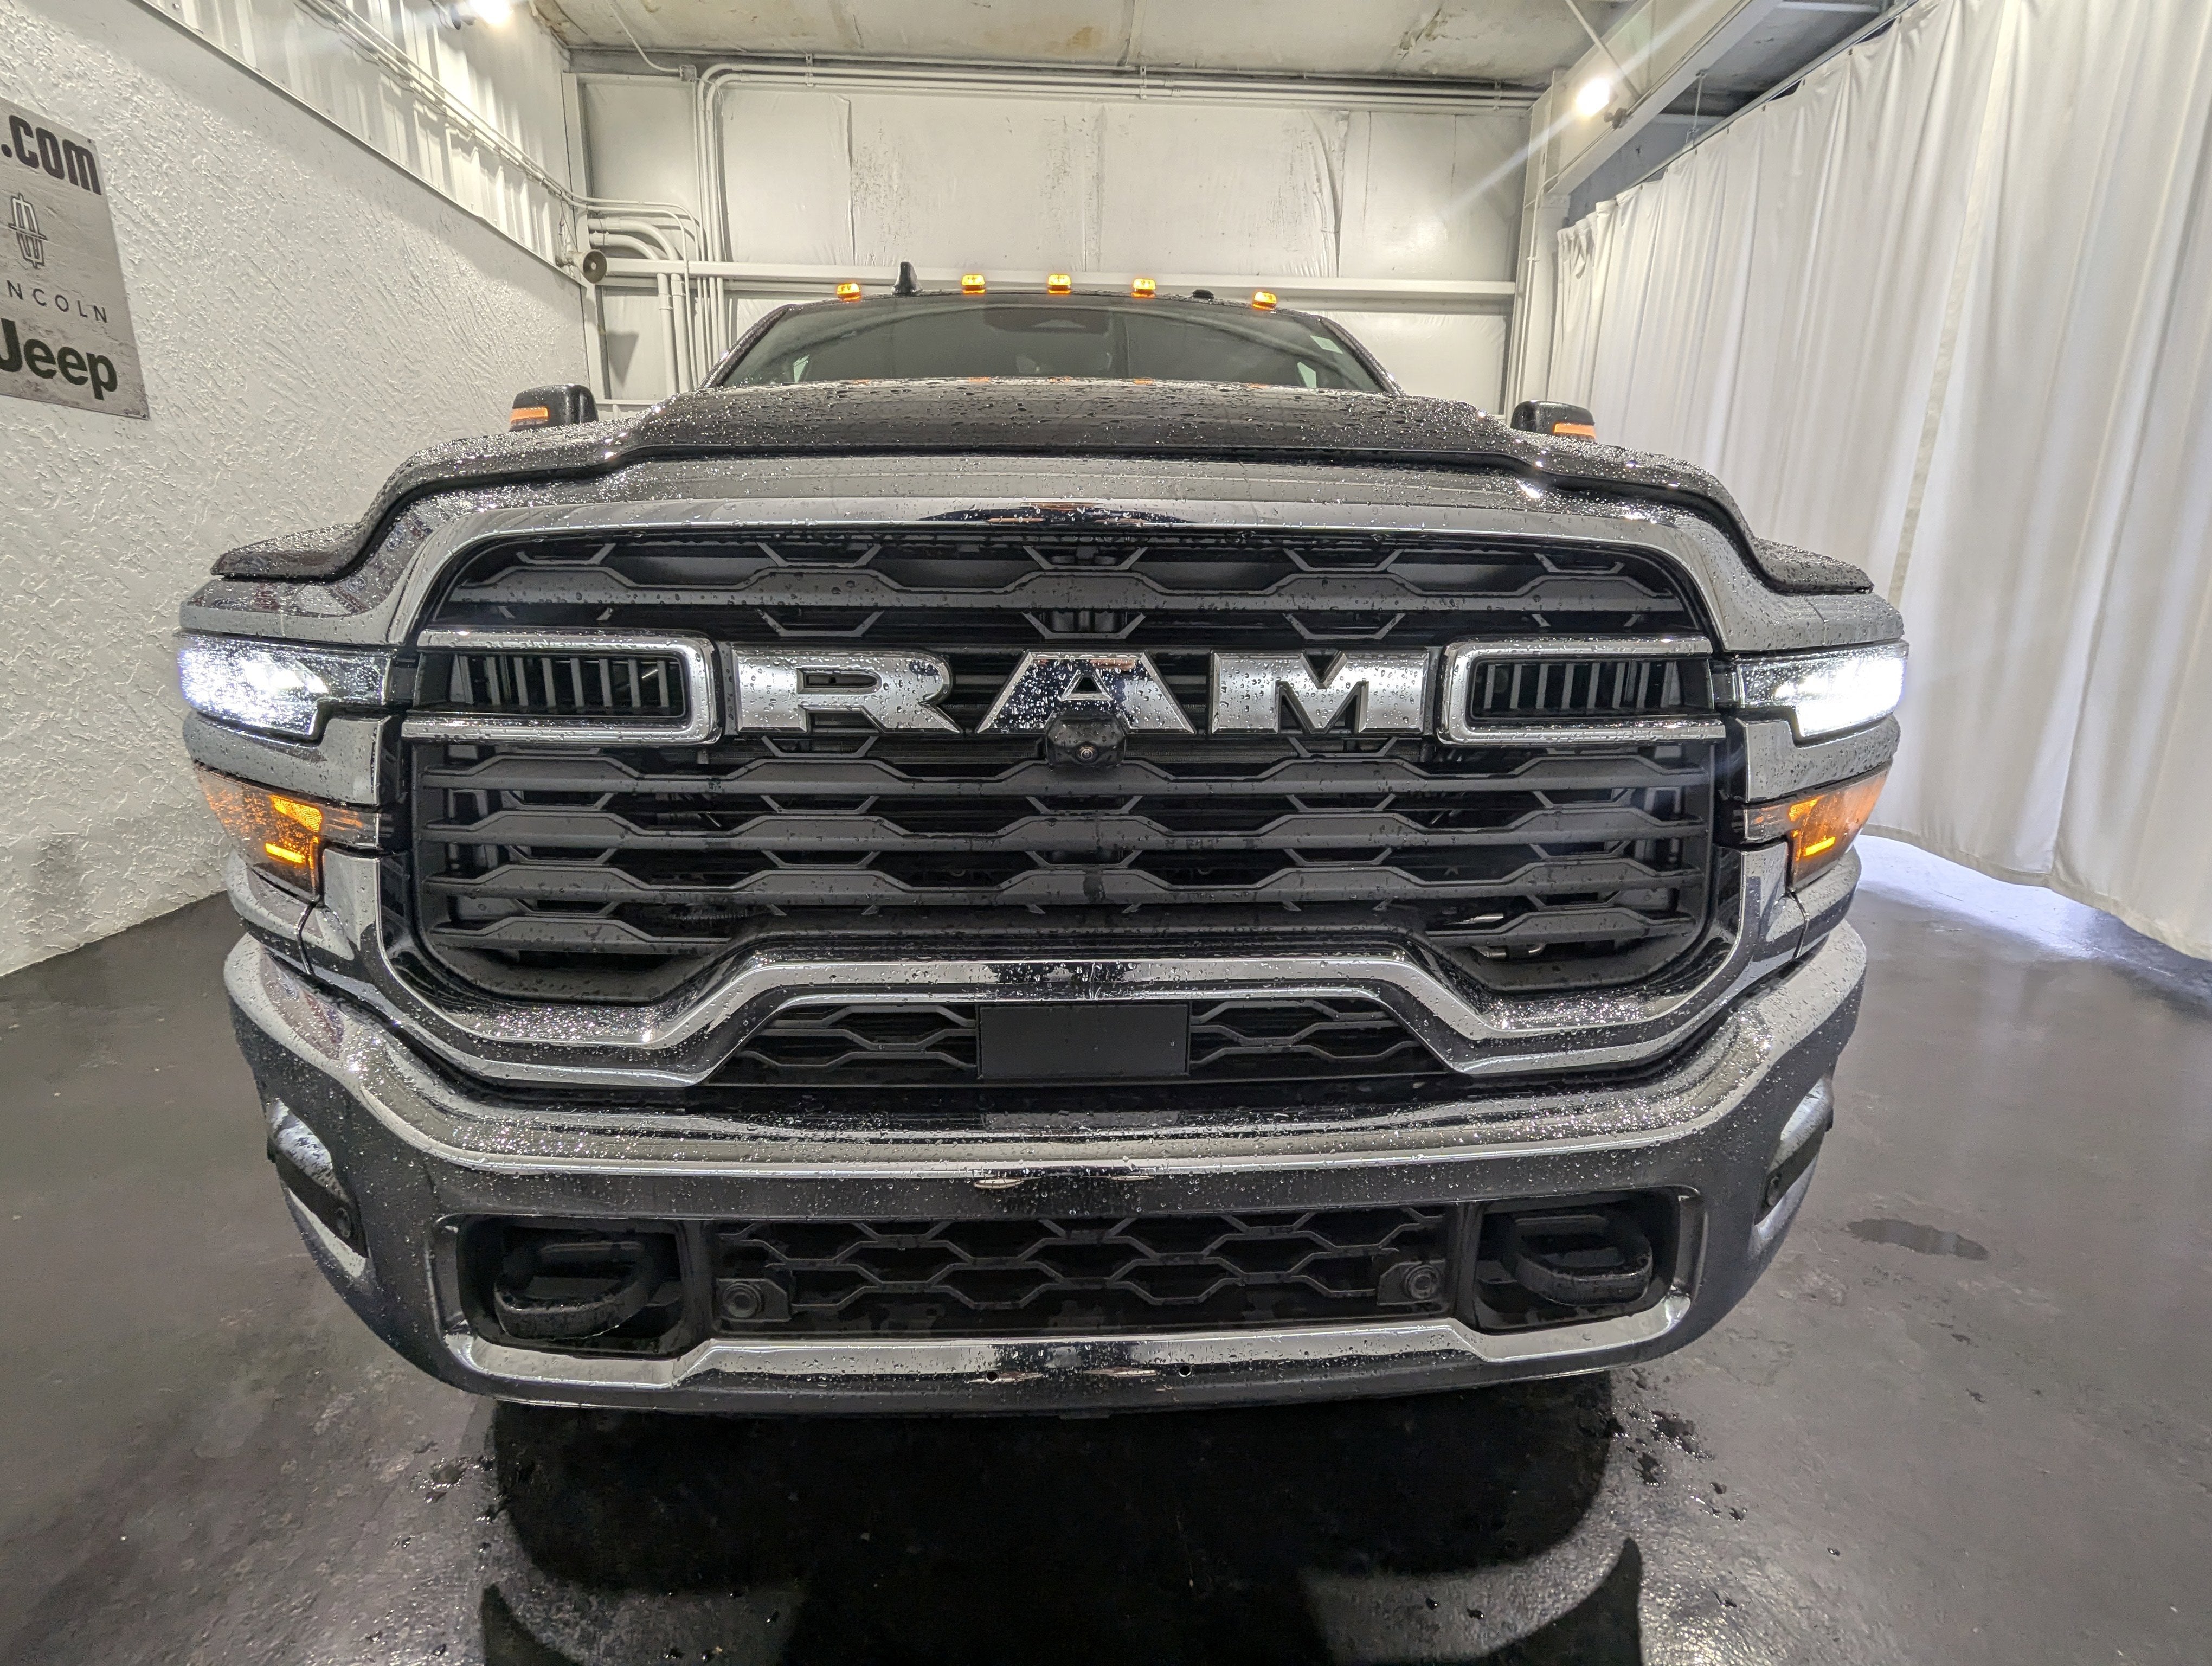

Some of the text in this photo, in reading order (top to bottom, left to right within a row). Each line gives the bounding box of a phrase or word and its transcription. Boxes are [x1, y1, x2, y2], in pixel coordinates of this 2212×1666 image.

[7, 280, 107, 323] NCOLN
[0, 318, 118, 400] Jeep
[733, 649, 1428, 734] RAM
